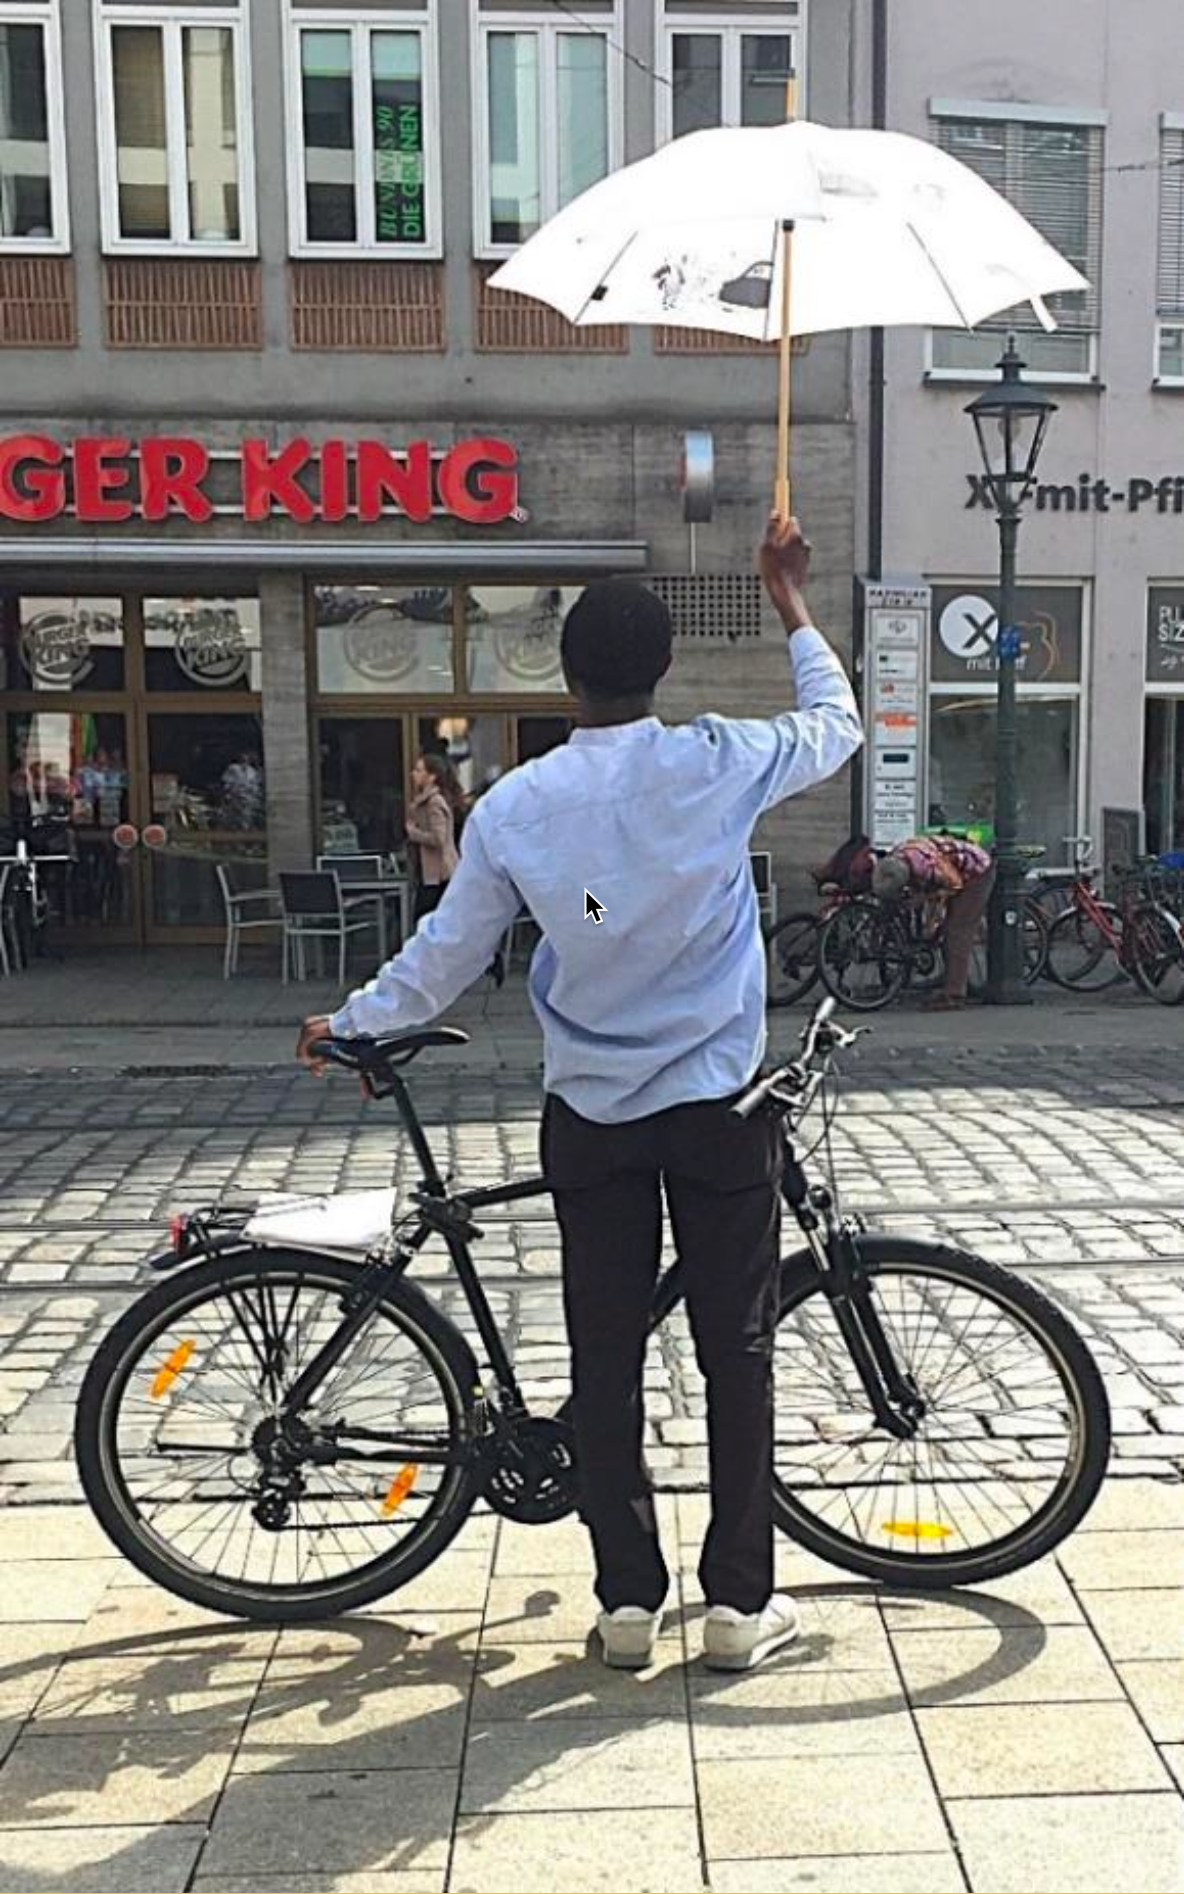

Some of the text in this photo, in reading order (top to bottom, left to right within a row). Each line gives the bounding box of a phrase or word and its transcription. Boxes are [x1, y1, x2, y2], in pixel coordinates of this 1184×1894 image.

[376, 105, 394, 131] 90
[399, 105, 420, 237] DIE GRÜNEN
[0, 434, 519, 524] GER KING
[33, 637, 90, 665] KING
[966, 656, 991, 671] mit
